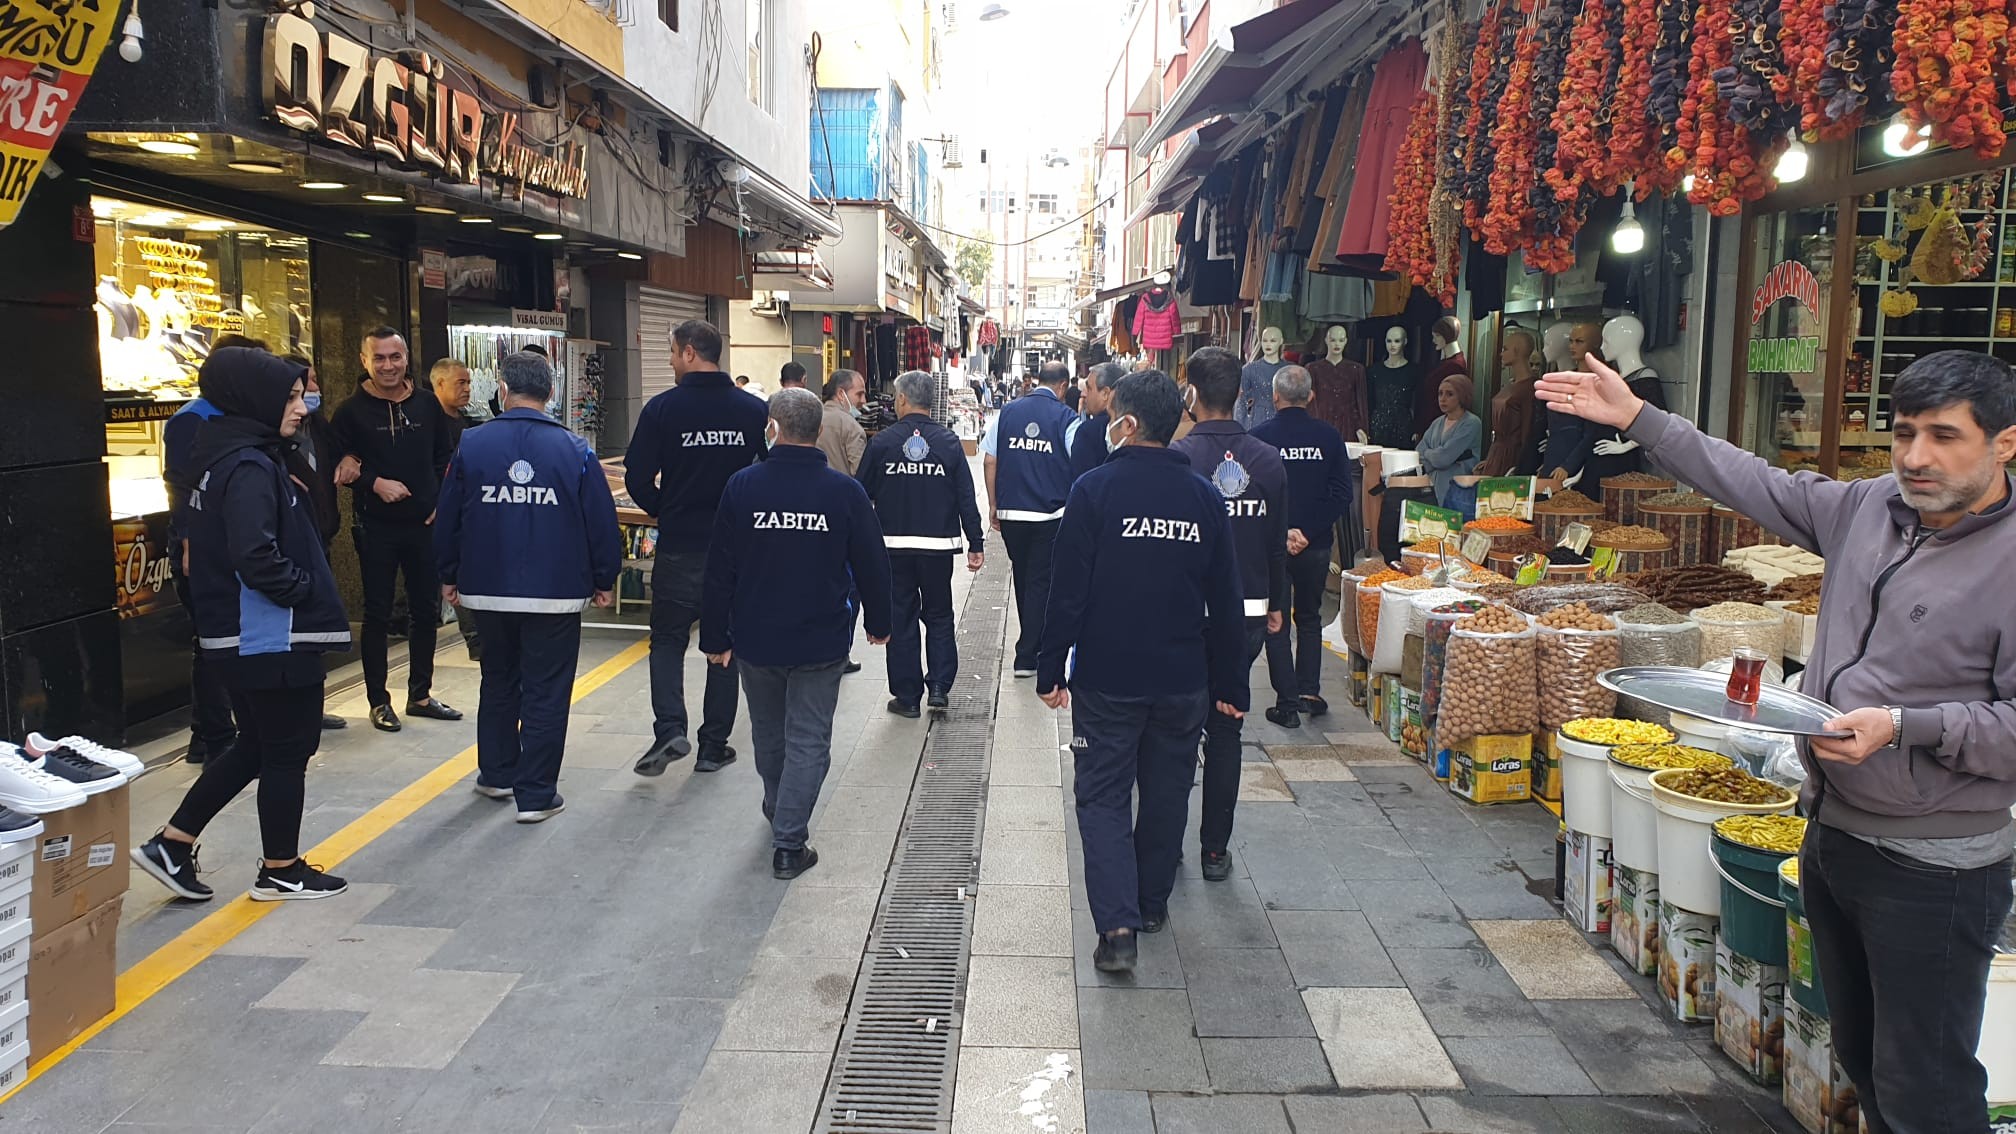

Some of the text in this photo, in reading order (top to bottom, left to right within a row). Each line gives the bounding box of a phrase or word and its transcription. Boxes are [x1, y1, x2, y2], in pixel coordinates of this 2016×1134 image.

[263, 0, 480, 185] ÖZGÜR
[1752, 260, 1819, 325] SAKARYA
[1747, 336, 1819, 373] BAHARAT
[111, 407, 135, 419] SAAT
[138, 407, 146, 418] &
[681, 430, 746, 447] ZABITA
[1008, 437, 1053, 454] ZABITA
[885, 462, 946, 476] ZABITA
[481, 485, 559, 505] ZABITA
[753, 511, 829, 531] ZABITA
[1121, 517, 1201, 543] ZABITA
[1456, 751, 1472, 767] Loras
[1492, 761, 1520, 771] Loras
[1620, 871, 1636, 894] Loras
